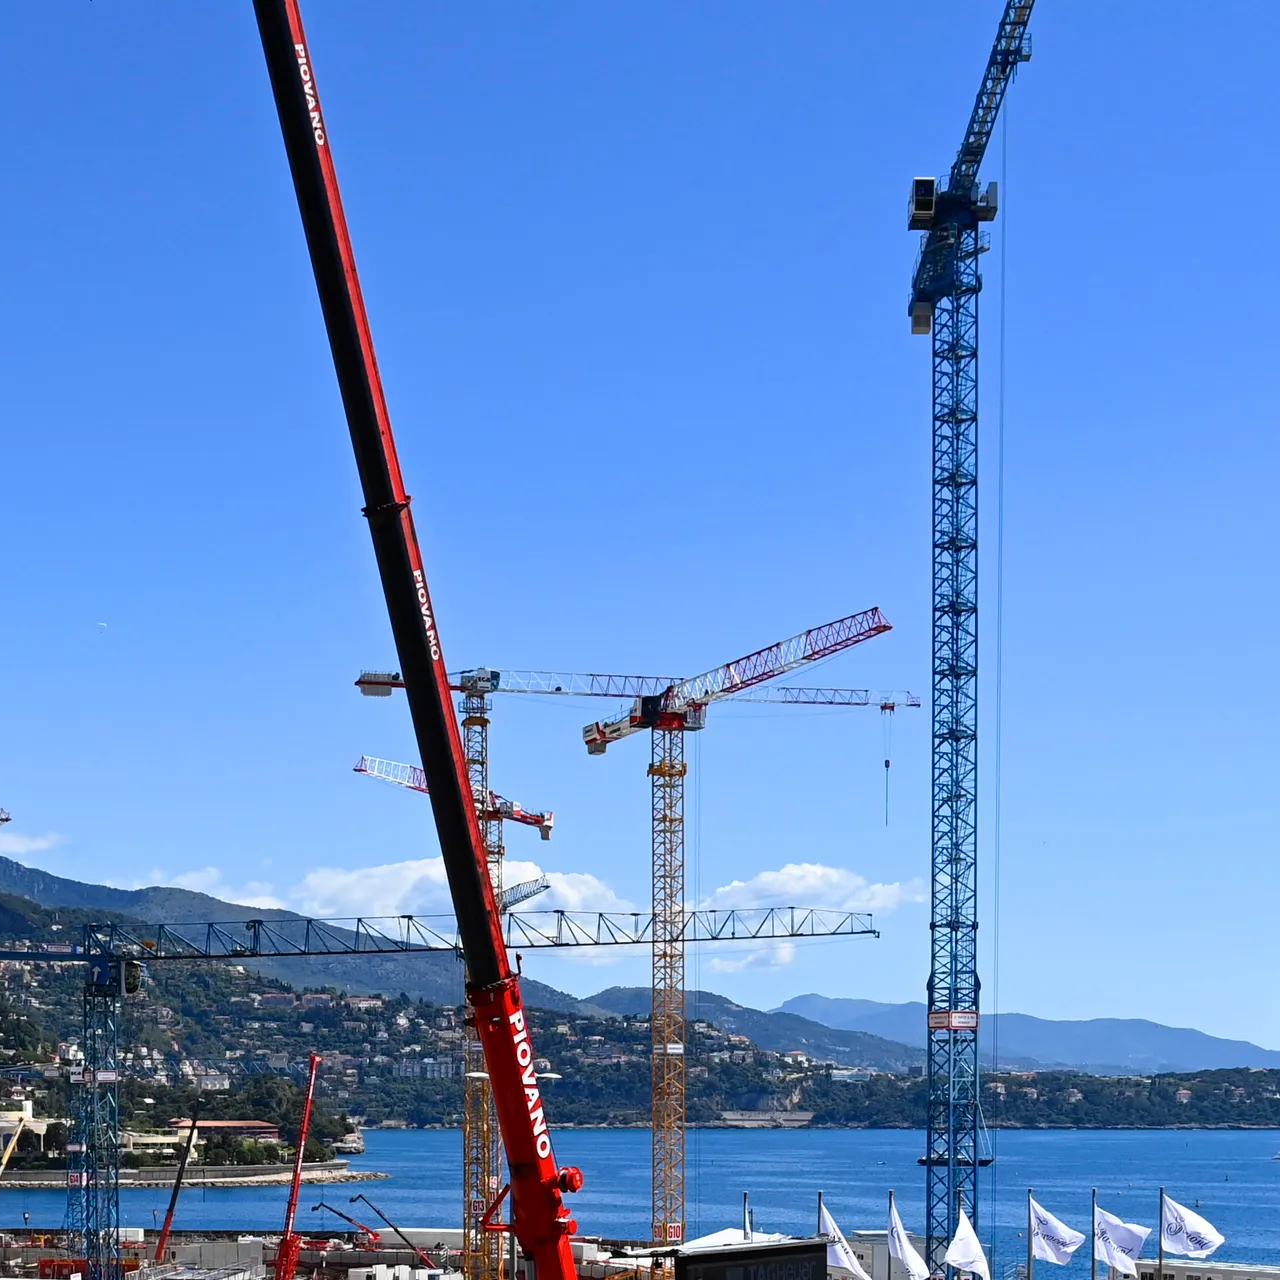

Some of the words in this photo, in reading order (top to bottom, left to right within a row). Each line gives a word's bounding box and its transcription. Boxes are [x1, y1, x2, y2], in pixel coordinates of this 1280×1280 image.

[294, 42, 325, 147] PIOVANO
[412, 568, 441, 661] PIOVANO
[508, 1010, 552, 1159] PIOVANO
[473, 1200, 485, 1211] G13
[668, 1225, 681, 1239] G10
